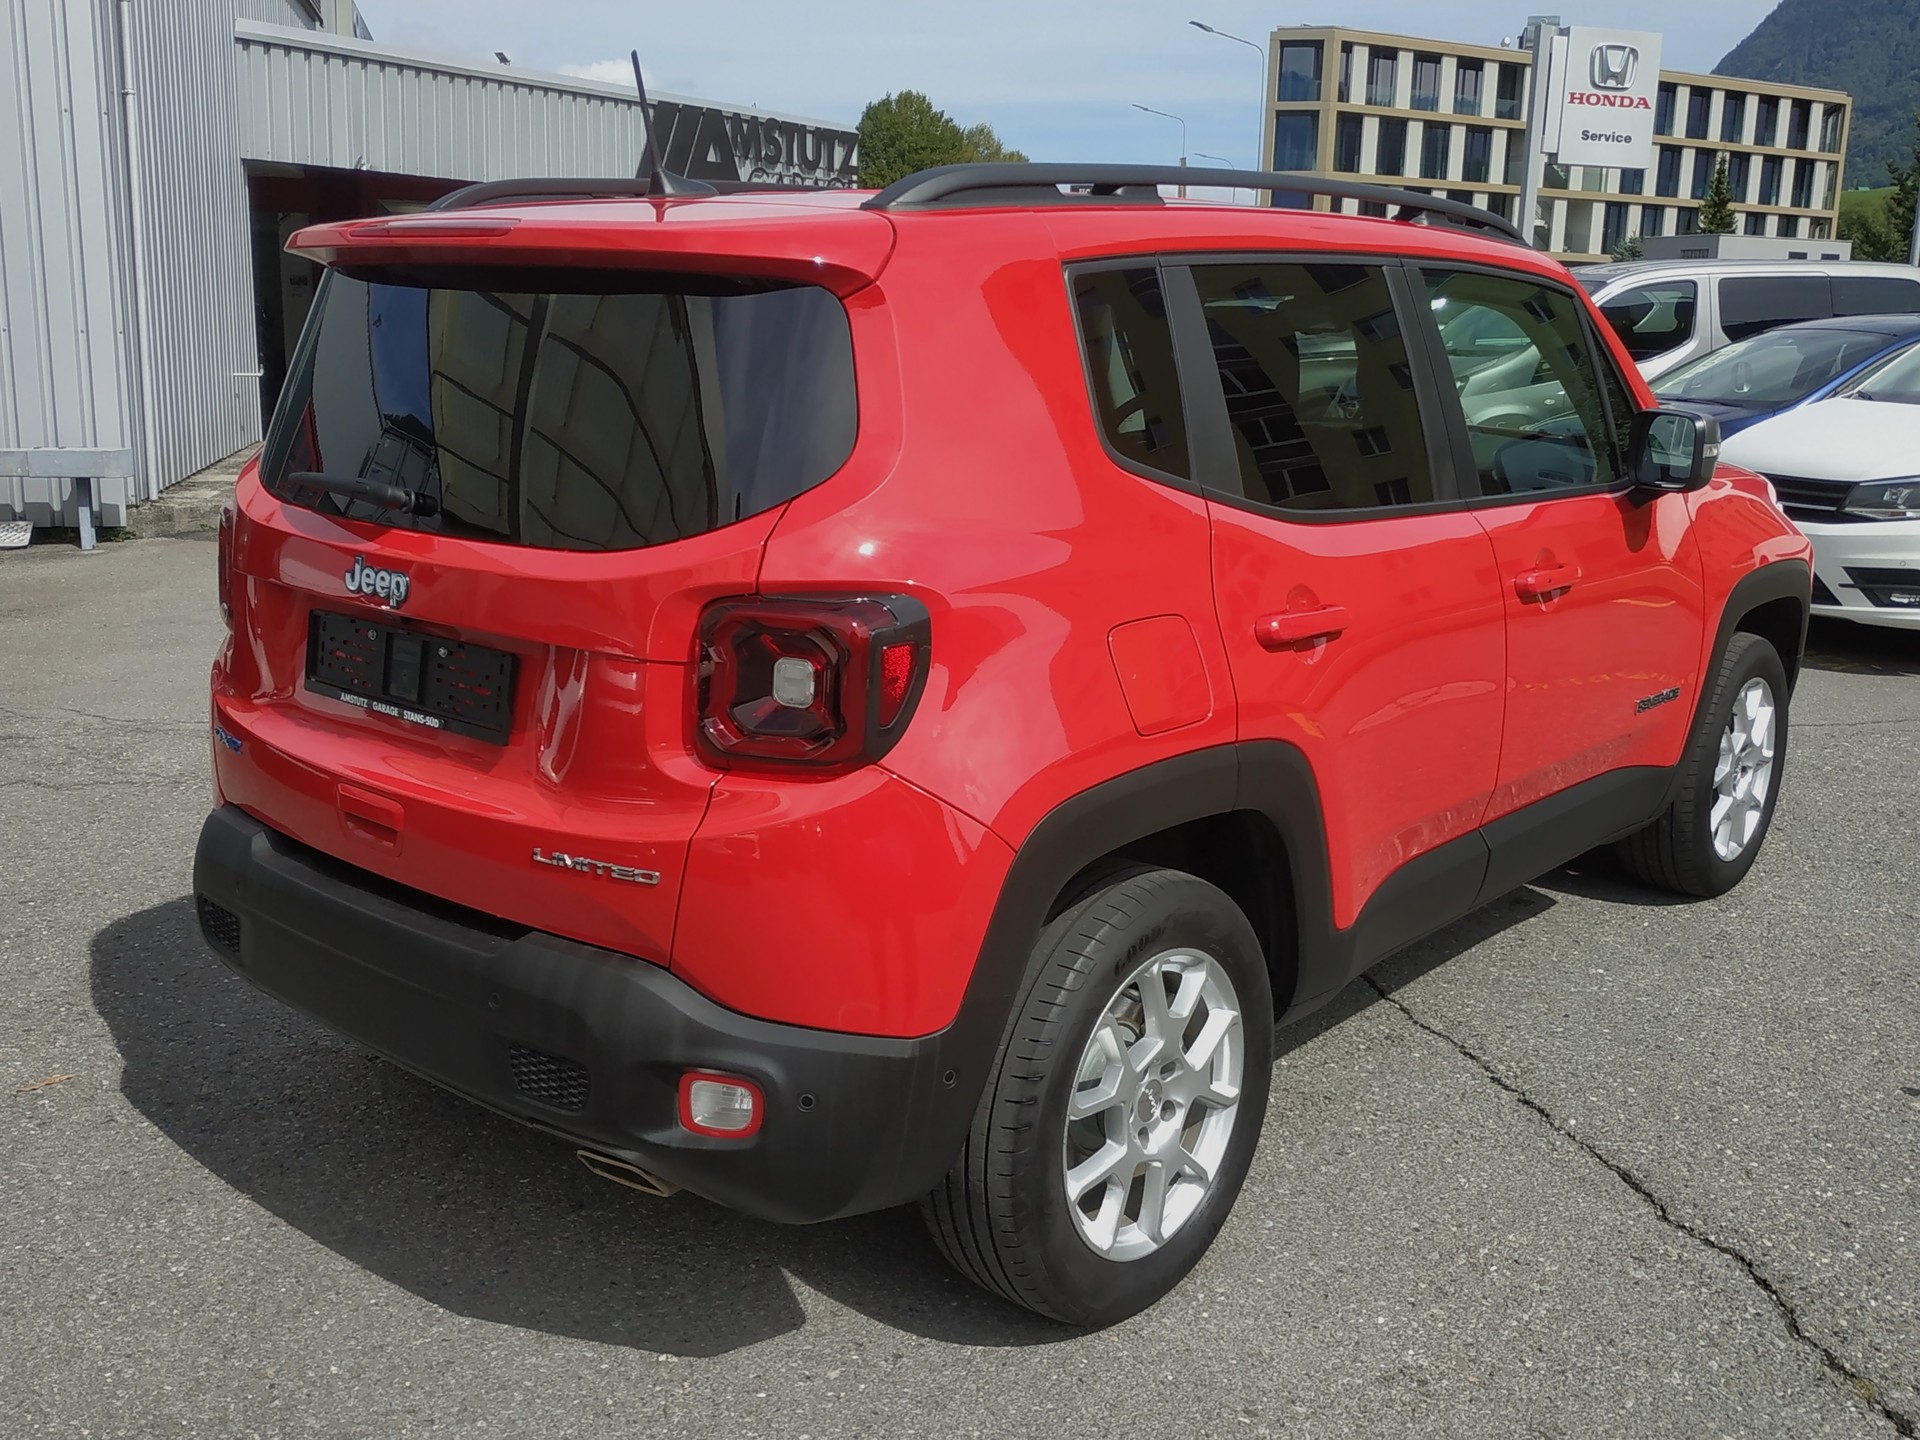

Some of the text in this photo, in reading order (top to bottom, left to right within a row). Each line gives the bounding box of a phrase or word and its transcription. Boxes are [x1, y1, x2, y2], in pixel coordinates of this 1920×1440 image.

[1568, 92, 1651, 110] HONDA
[684, 107, 860, 182] AMSTUTZ
[1581, 130, 1632, 144] Service
[344, 554, 409, 608] Jeep
[340, 692, 368, 708] AMSTUTZ
[372, 701, 399, 717] GARAGE
[532, 847, 660, 885] LIMITED
